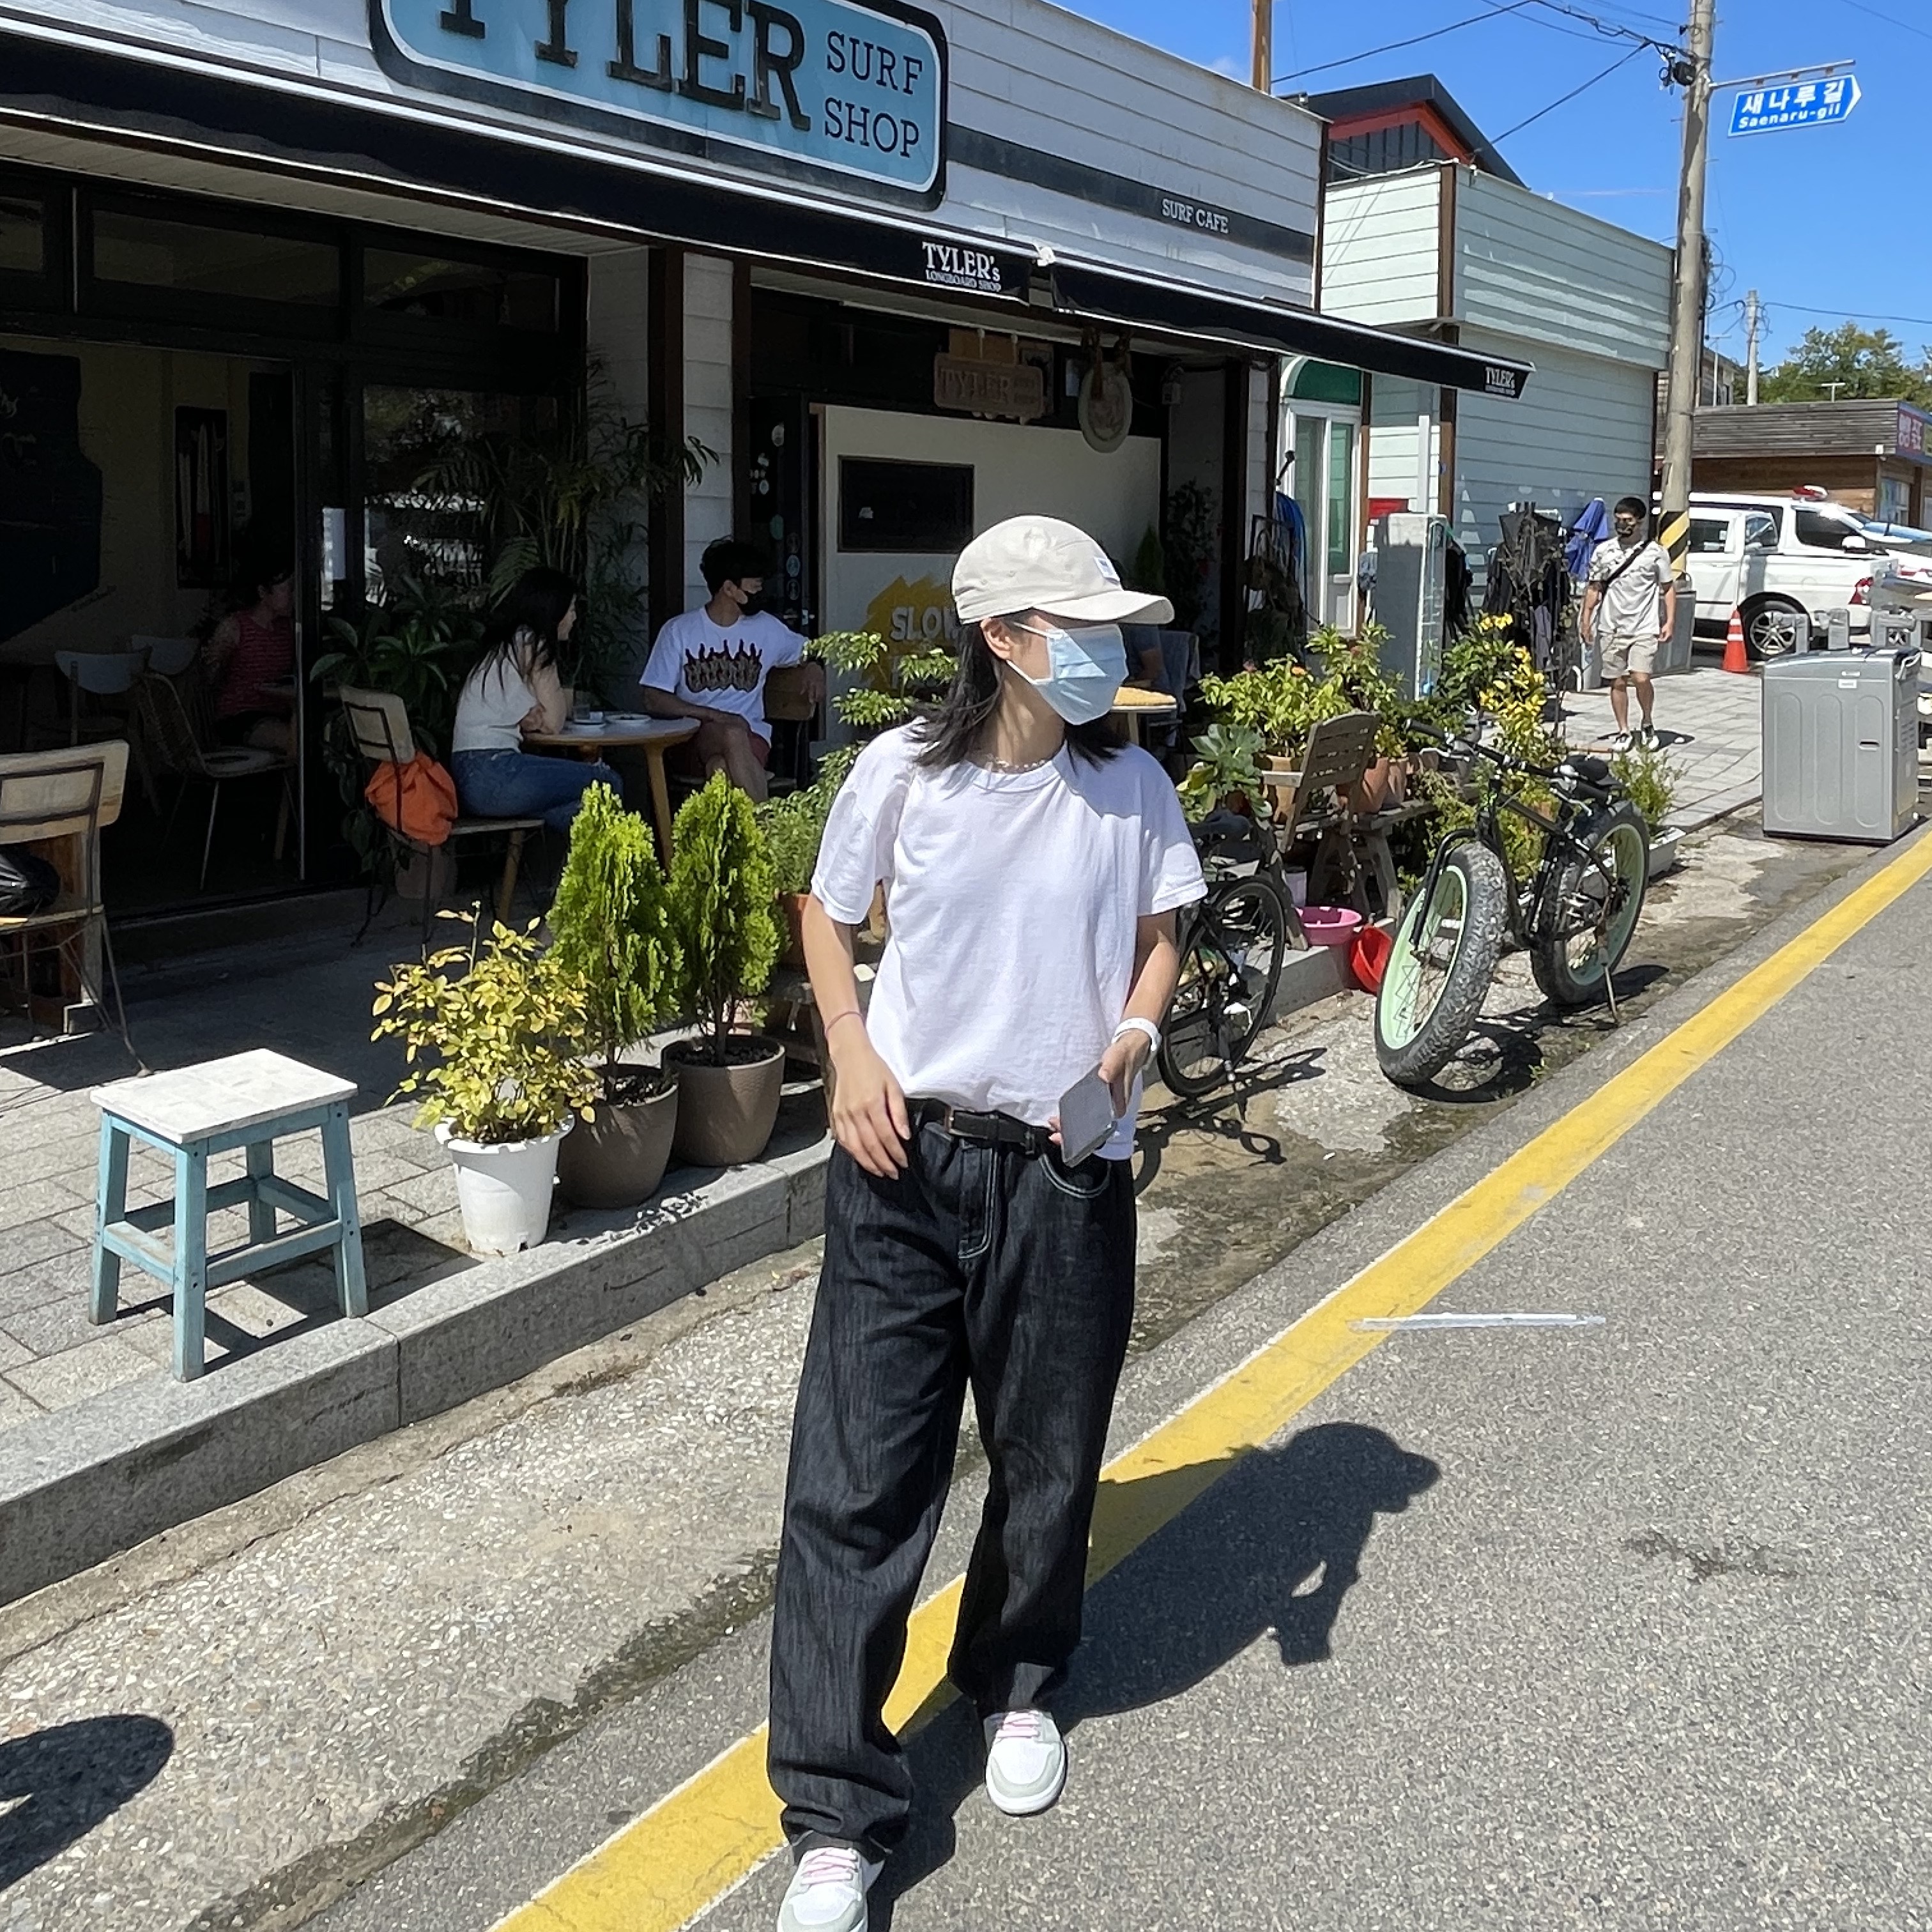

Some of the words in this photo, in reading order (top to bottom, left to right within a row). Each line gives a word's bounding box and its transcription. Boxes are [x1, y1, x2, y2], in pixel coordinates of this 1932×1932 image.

[440, 0, 811, 132] LER
[827, 31, 923, 95] SURF
[1738, 102, 1841, 130] Saenaru-gil
[1741, 79, 1846, 115] 새나루길
[825, 97, 919, 158] SHOP
[1162, 198, 1193, 224] SURF
[1196, 208, 1229, 234] CAFE
